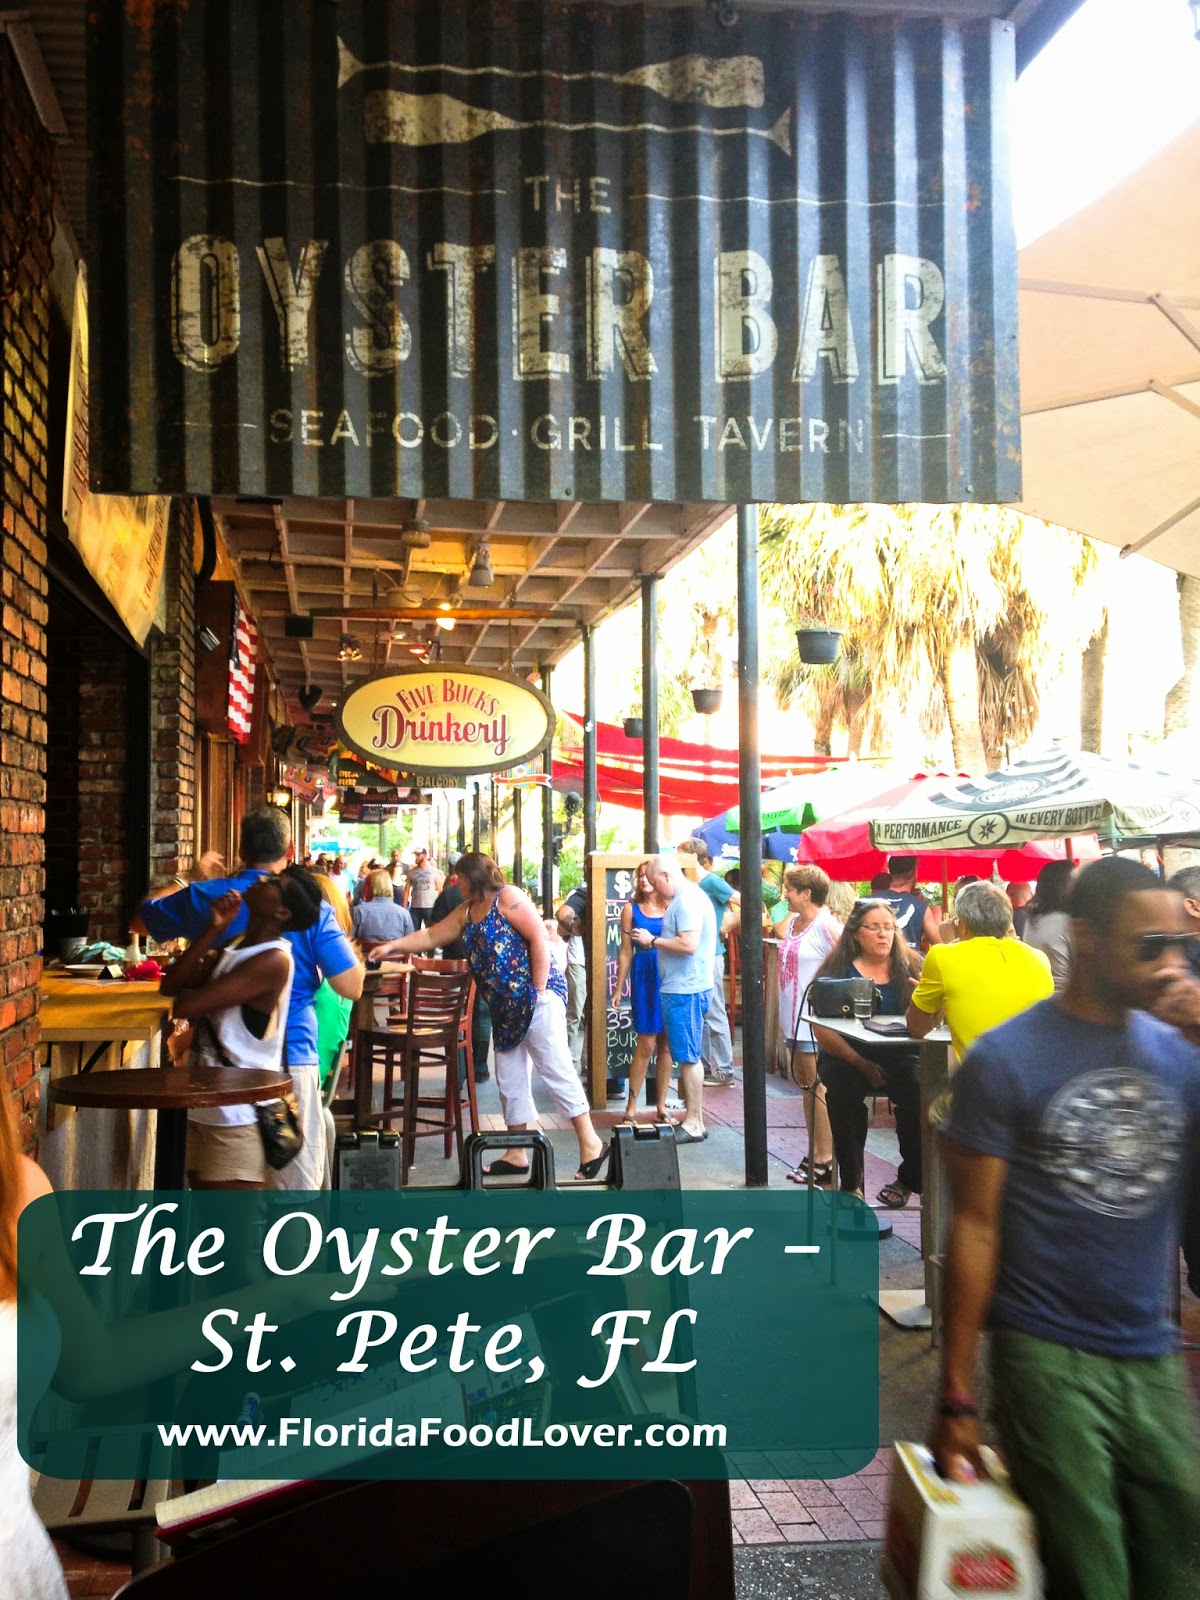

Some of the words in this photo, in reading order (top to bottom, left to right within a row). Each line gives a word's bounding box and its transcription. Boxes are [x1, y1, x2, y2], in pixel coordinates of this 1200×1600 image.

[524, 175, 612, 214] THE
[170, 233, 659, 382] OYSTER
[713, 249, 948, 387] BAR
[269, 408, 499, 451] SEAFOOD
[530, 413, 664, 454] GRILL
[692, 414, 865, 454] TAVERN
[395, 683, 438, 714] FIVE
[442, 678, 500, 717] BUCKS
[371, 704, 511, 757] Drinkery
[416, 774, 460, 789] BALCONY
[875, 823, 881, 838] A
[884, 819, 963, 840] PERFORMANCE
[1015, 813, 1028, 824] IN
[1029, 808, 1066, 827] EVERY
[1064, 803, 1103, 826] BOTTLE
[607, 1029, 638, 1048] BUR
